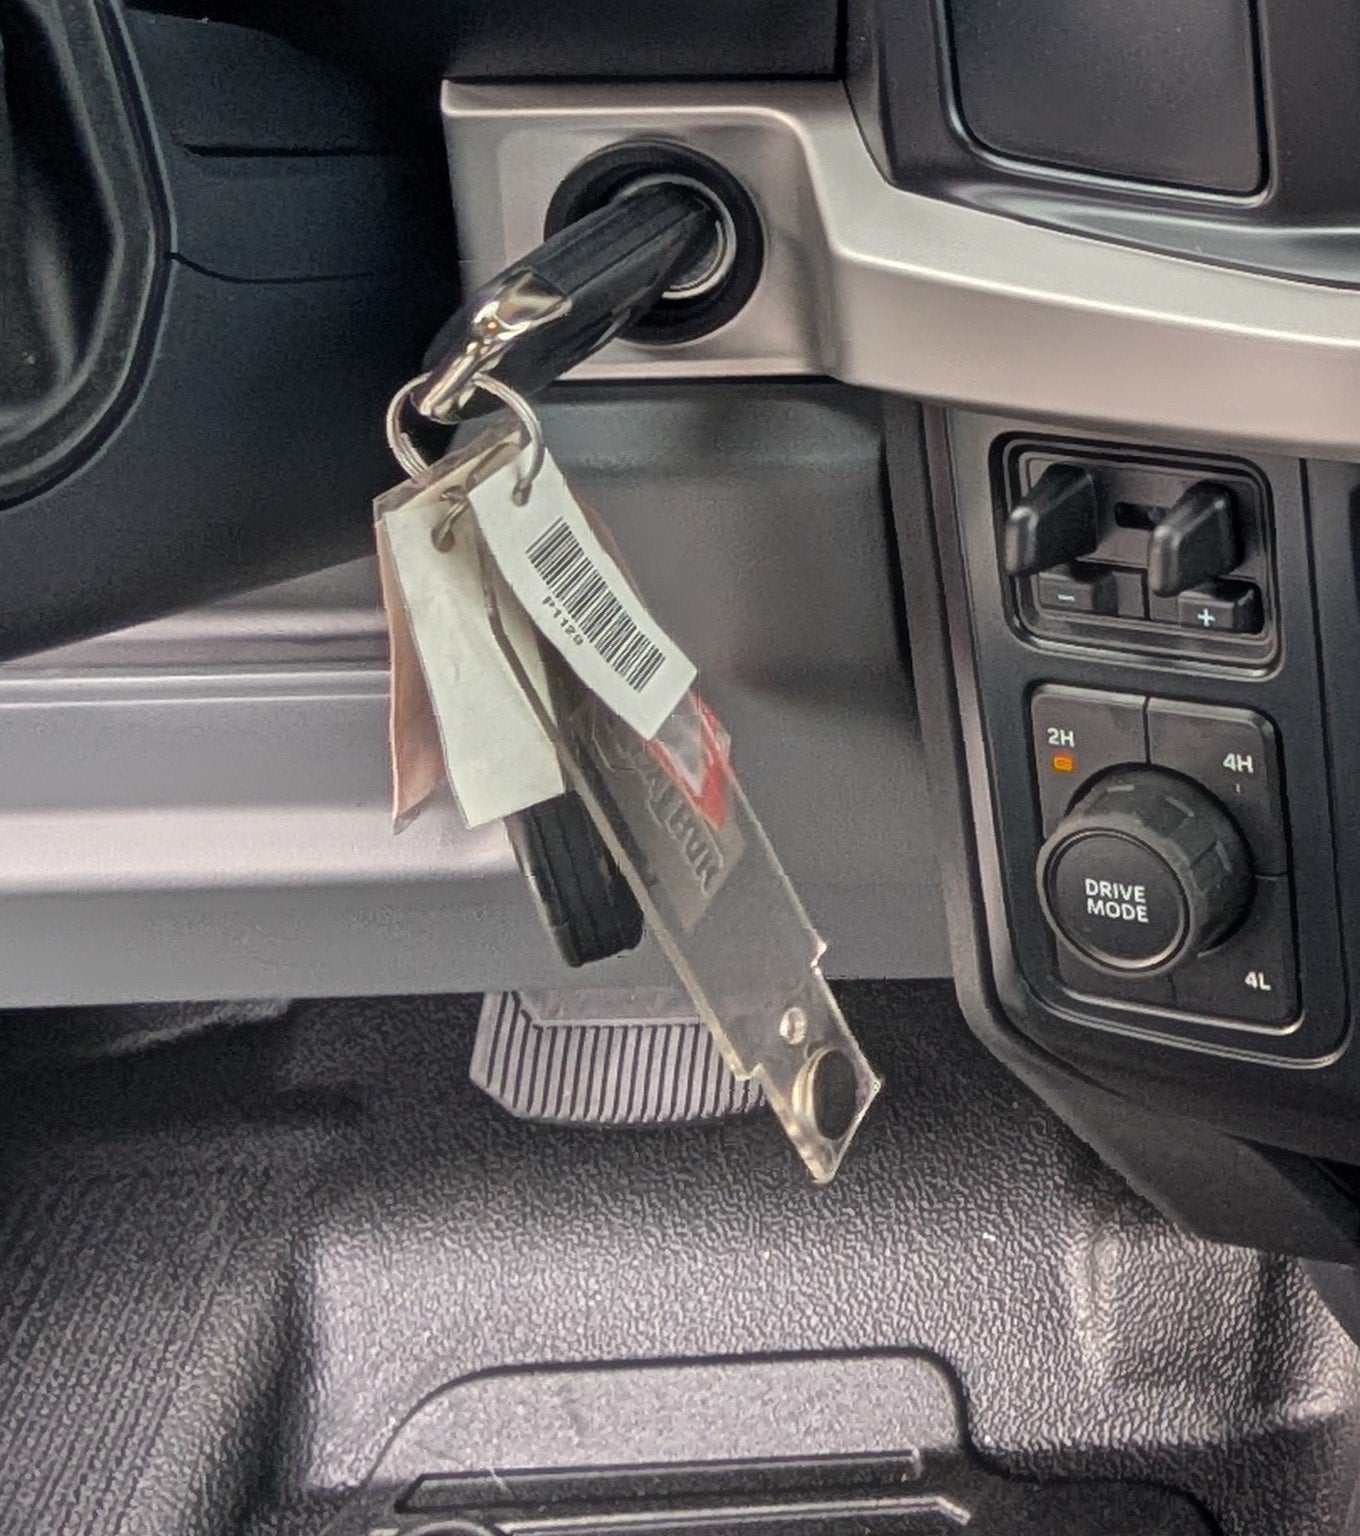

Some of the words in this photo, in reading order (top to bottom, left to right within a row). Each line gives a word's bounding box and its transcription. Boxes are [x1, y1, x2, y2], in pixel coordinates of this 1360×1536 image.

[1047, 728, 1075, 748] 2H
[1222, 752, 1254, 774] 4H
[1084, 878, 1146, 904] DRIVE
[1086, 897, 1150, 924] MODE
[1244, 971, 1271, 991] 4L
